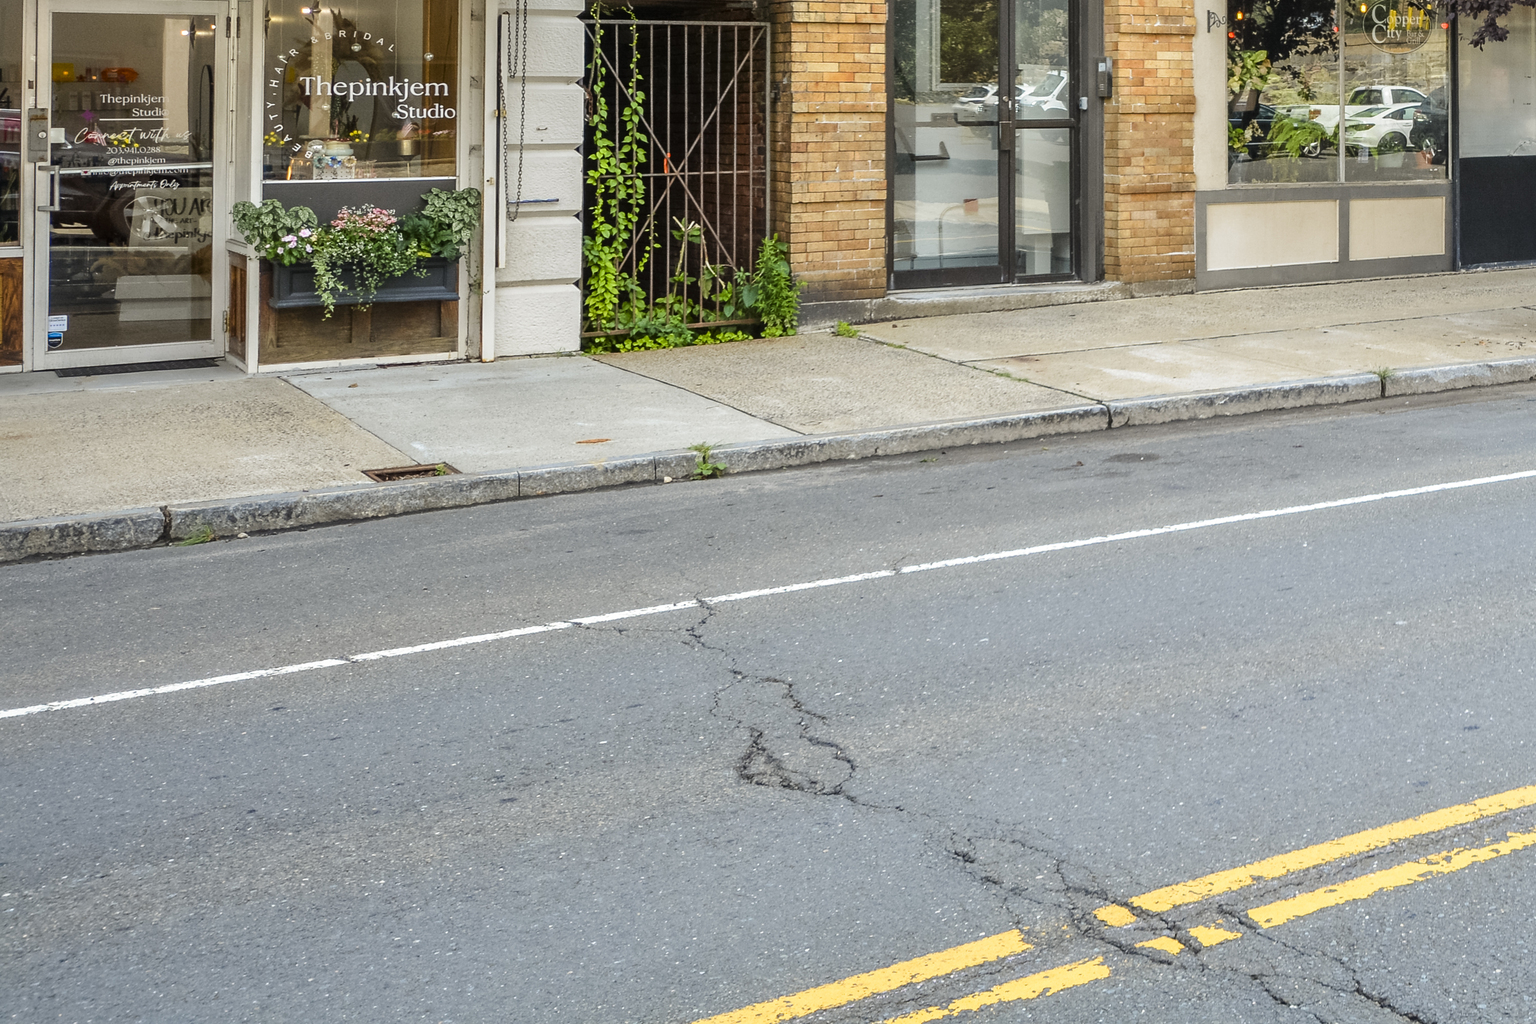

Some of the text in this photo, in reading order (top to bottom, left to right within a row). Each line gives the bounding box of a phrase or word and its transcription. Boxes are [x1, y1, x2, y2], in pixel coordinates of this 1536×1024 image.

[1371, 4, 1422, 27] Copper
[325, 30, 395, 53] BRIDAL
[1371, 24, 1402, 43] City
[1418, 30, 1424, 38] &
[299, 76, 448, 102] Thepinkjem
[100, 94, 169, 106] Thepinkjem
[132, 107, 169, 117] Studio
[396, 103, 456, 119] Studio
[74, 127, 192, 144] Connect with us
[108, 157, 166, 166] @thepinkjem
[109, 179, 180, 191] Appointments Only
